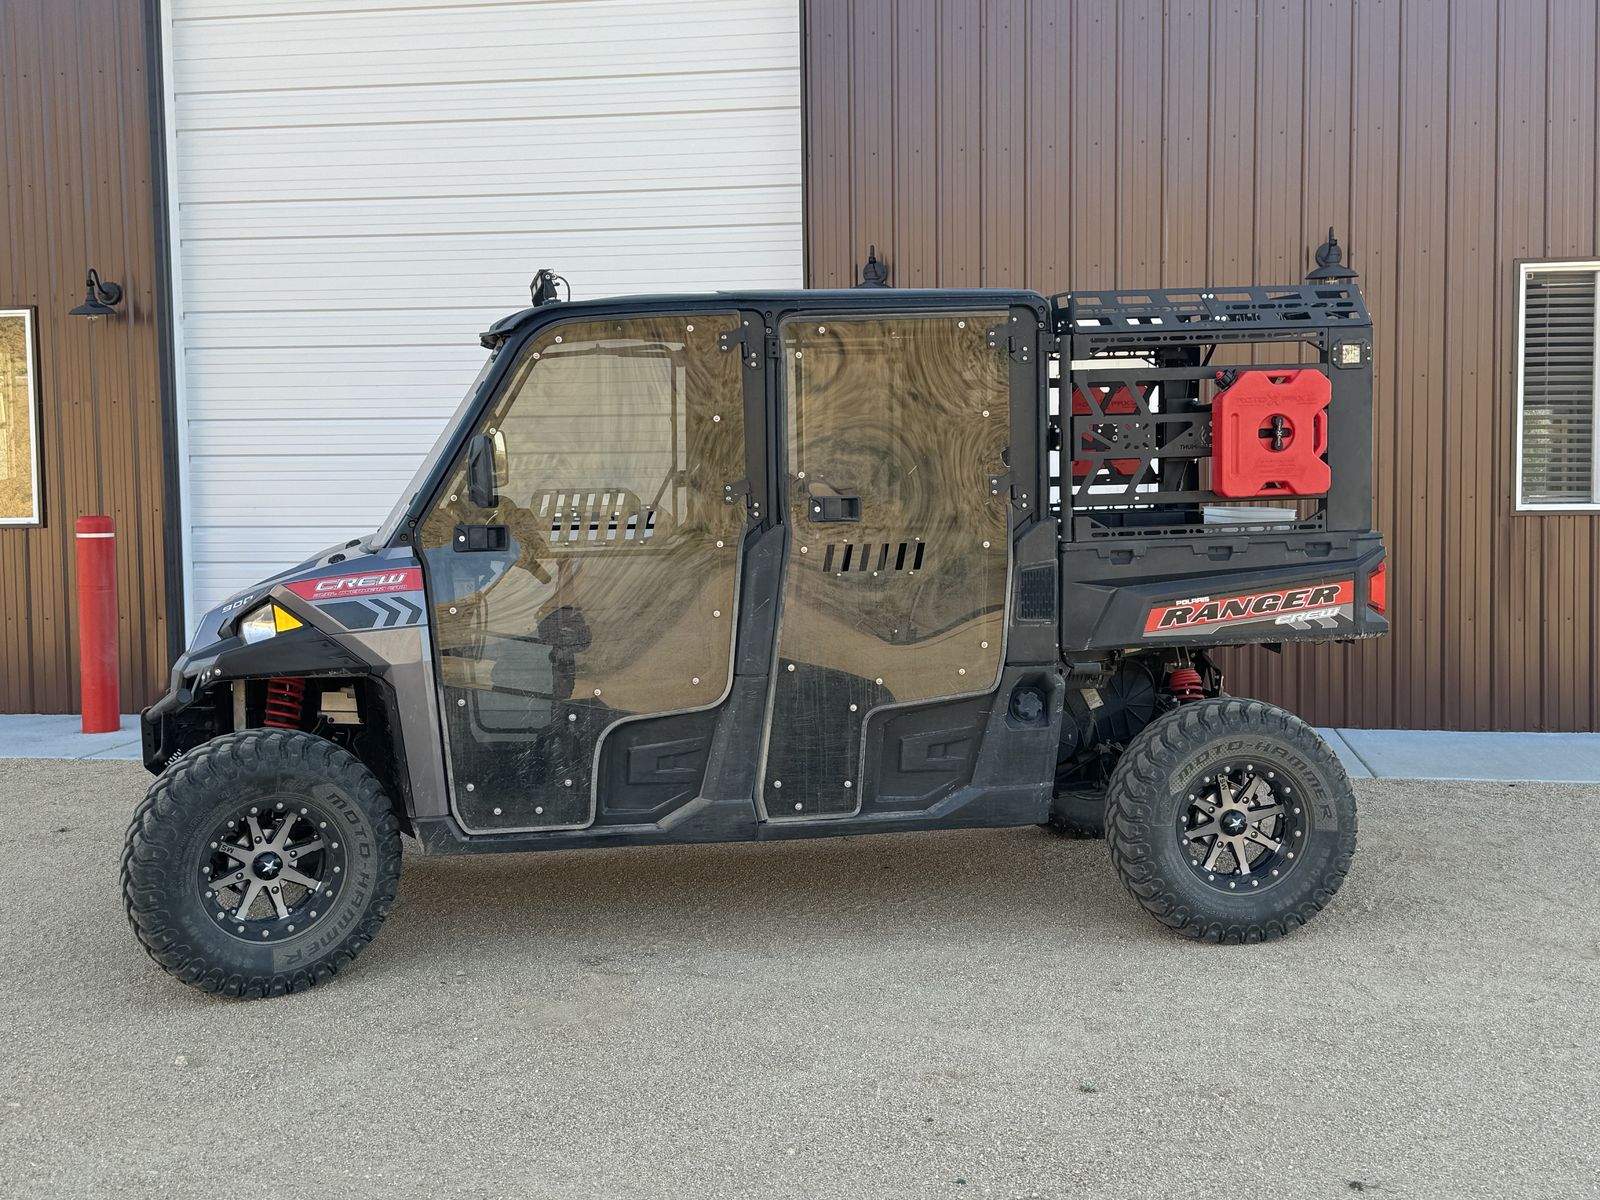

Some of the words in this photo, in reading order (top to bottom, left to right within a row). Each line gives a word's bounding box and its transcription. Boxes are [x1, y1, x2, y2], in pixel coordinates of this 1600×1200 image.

[315, 572, 407, 591] CREW
[1157, 585, 1341, 629] RANGER
[1176, 596, 1210, 606] POLARIS
[1274, 606, 1342, 625] CREW
